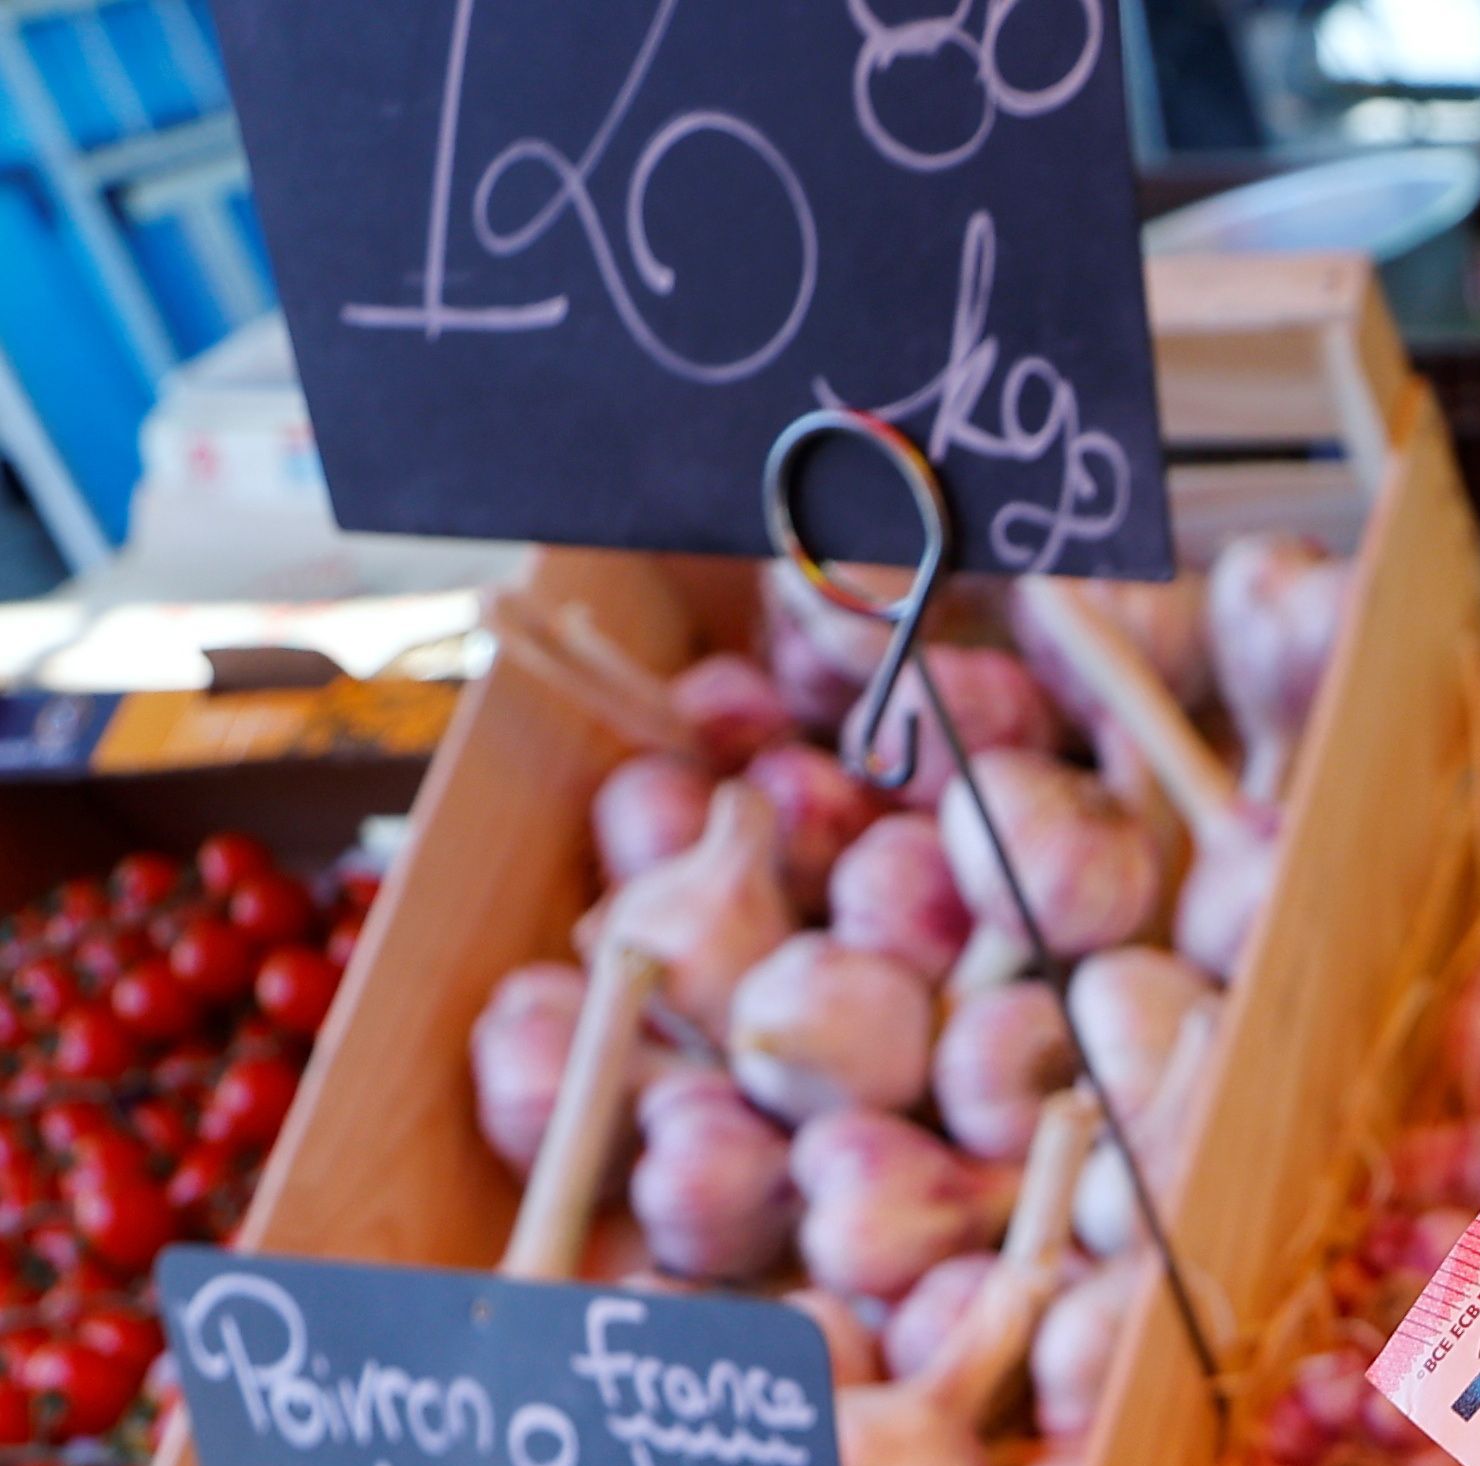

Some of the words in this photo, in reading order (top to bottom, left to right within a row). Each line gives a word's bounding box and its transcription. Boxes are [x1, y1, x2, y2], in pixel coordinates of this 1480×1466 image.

[180, 1272, 495, 1455] Poivron
[570, 1297, 817, 1428] France
[1451, 1303, 1480, 1340] ECB
